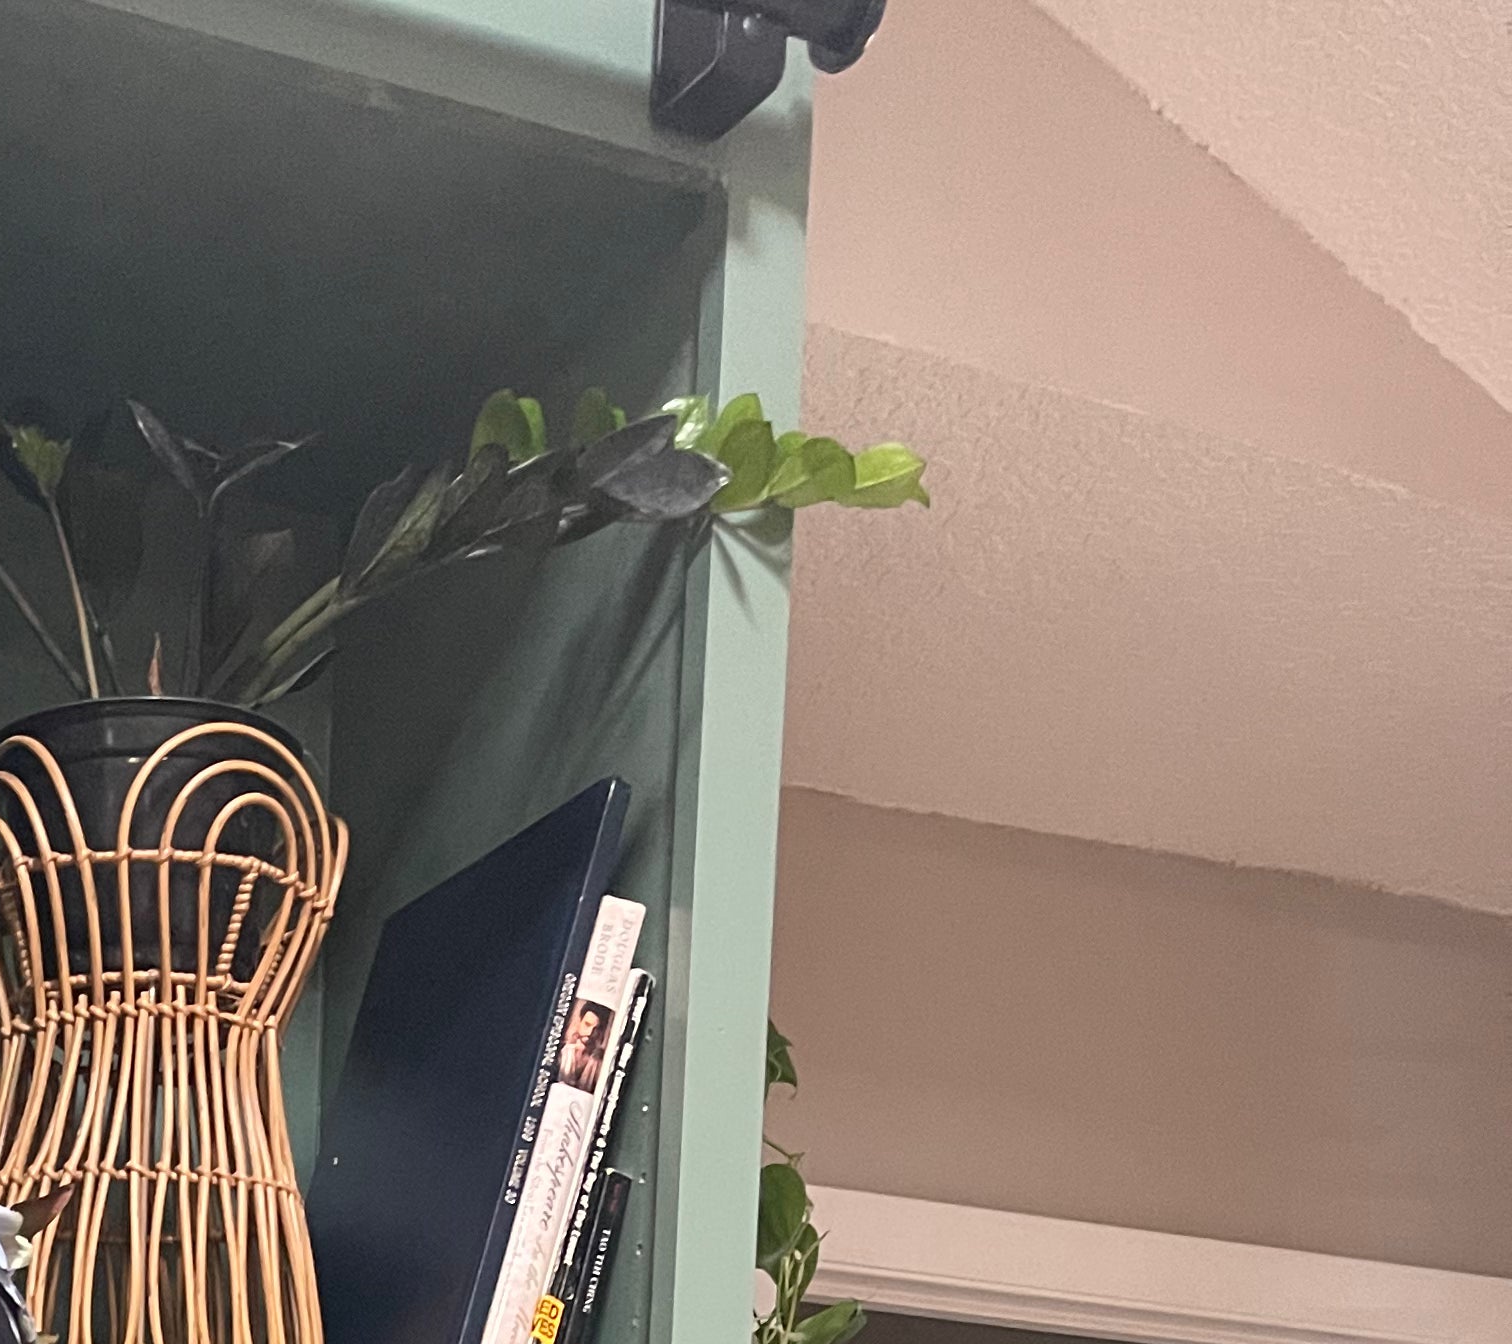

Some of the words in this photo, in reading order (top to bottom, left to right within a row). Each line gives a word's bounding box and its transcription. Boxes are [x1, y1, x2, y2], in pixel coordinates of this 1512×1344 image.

[591, 923, 614, 976] BRODE
[606, 919, 632, 993] DOUGLAS
[541, 1101, 583, 1231] Shakespeare
[598, 1229, 611, 1252] TAO
[582, 1277, 599, 1313] CHING
